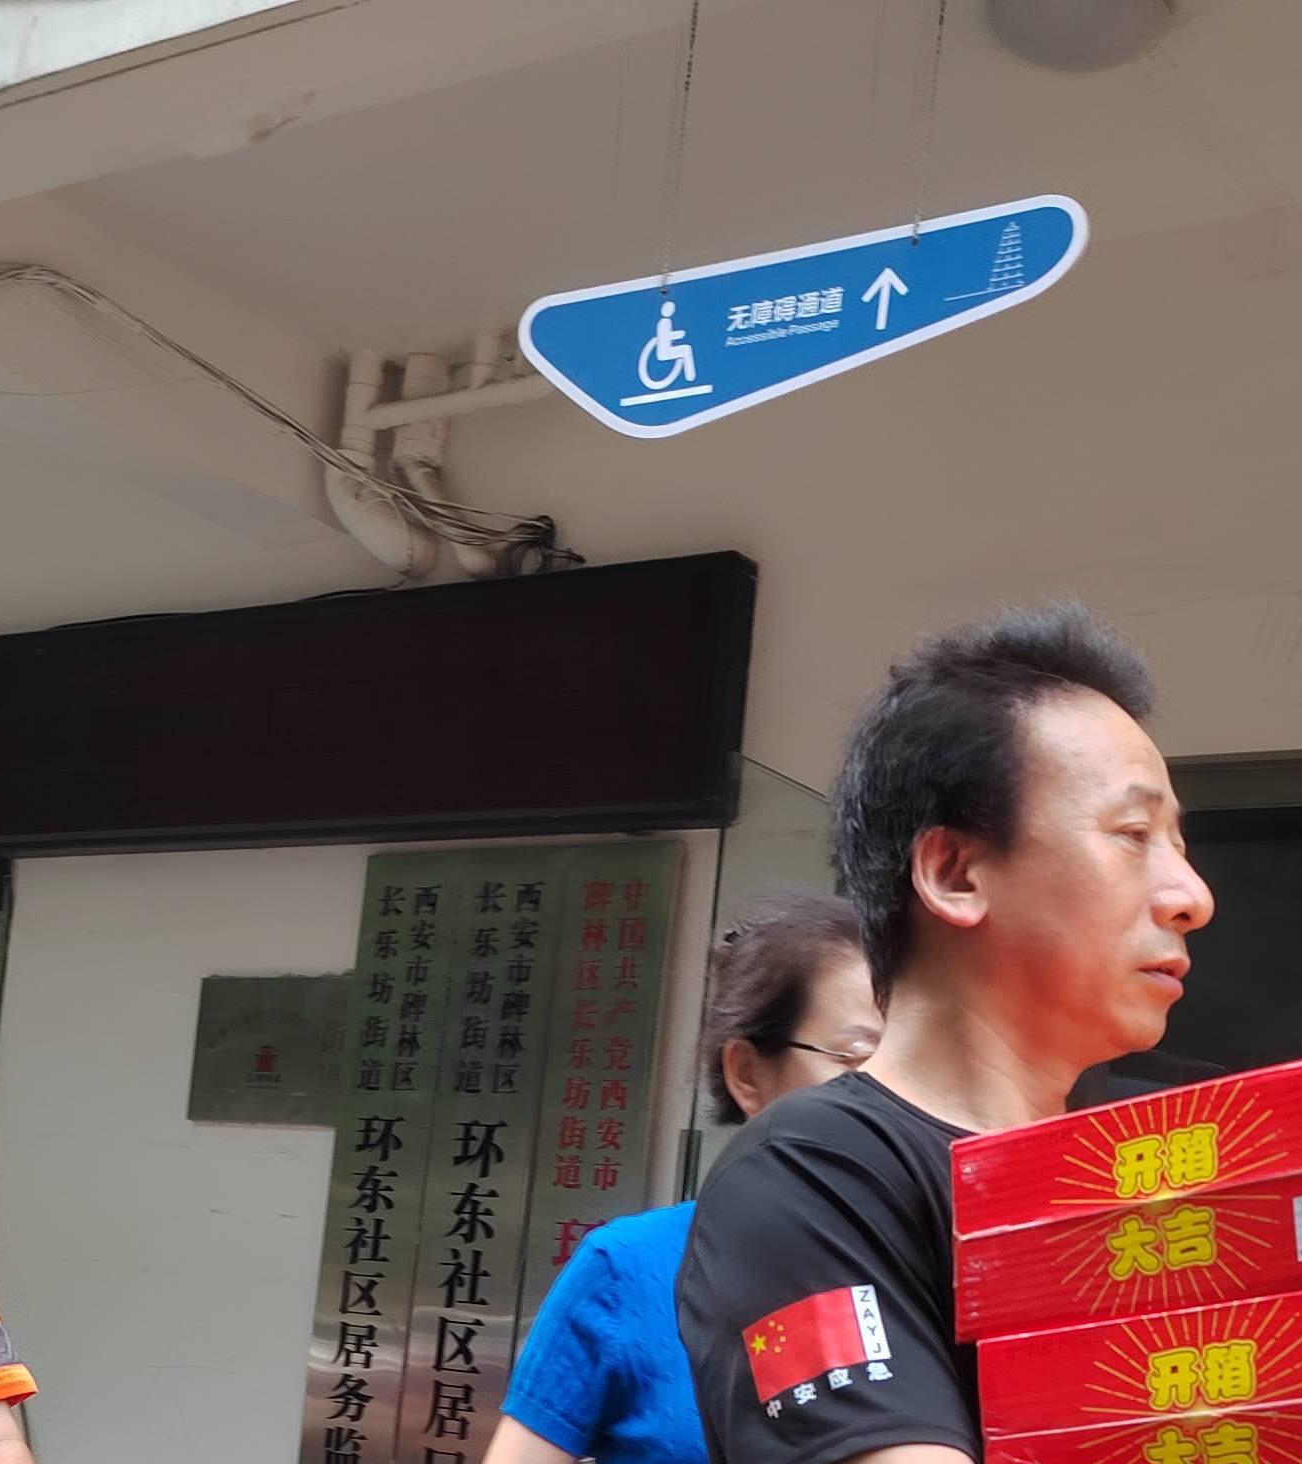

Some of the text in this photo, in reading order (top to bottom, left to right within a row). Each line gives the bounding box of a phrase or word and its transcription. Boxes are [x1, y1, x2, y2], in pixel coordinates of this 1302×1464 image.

[726, 287, 845, 332] 无障碍通道
[355, 885, 406, 1093] 长乐坊街道
[390, 885, 442, 1092] 西安市碑林区
[453, 881, 507, 1094] 长乐坊街道
[491, 882, 545, 1094] 西安市碑林区
[591, 877, 651, 1191] 中国共产党西安市
[1113, 1122, 1220, 1198] 开箱
[1106, 1206, 1217, 1281] 大吉
[858, 1289, 883, 1354] ZAYJ
[1146, 1339, 1258, 1409] 开箱
